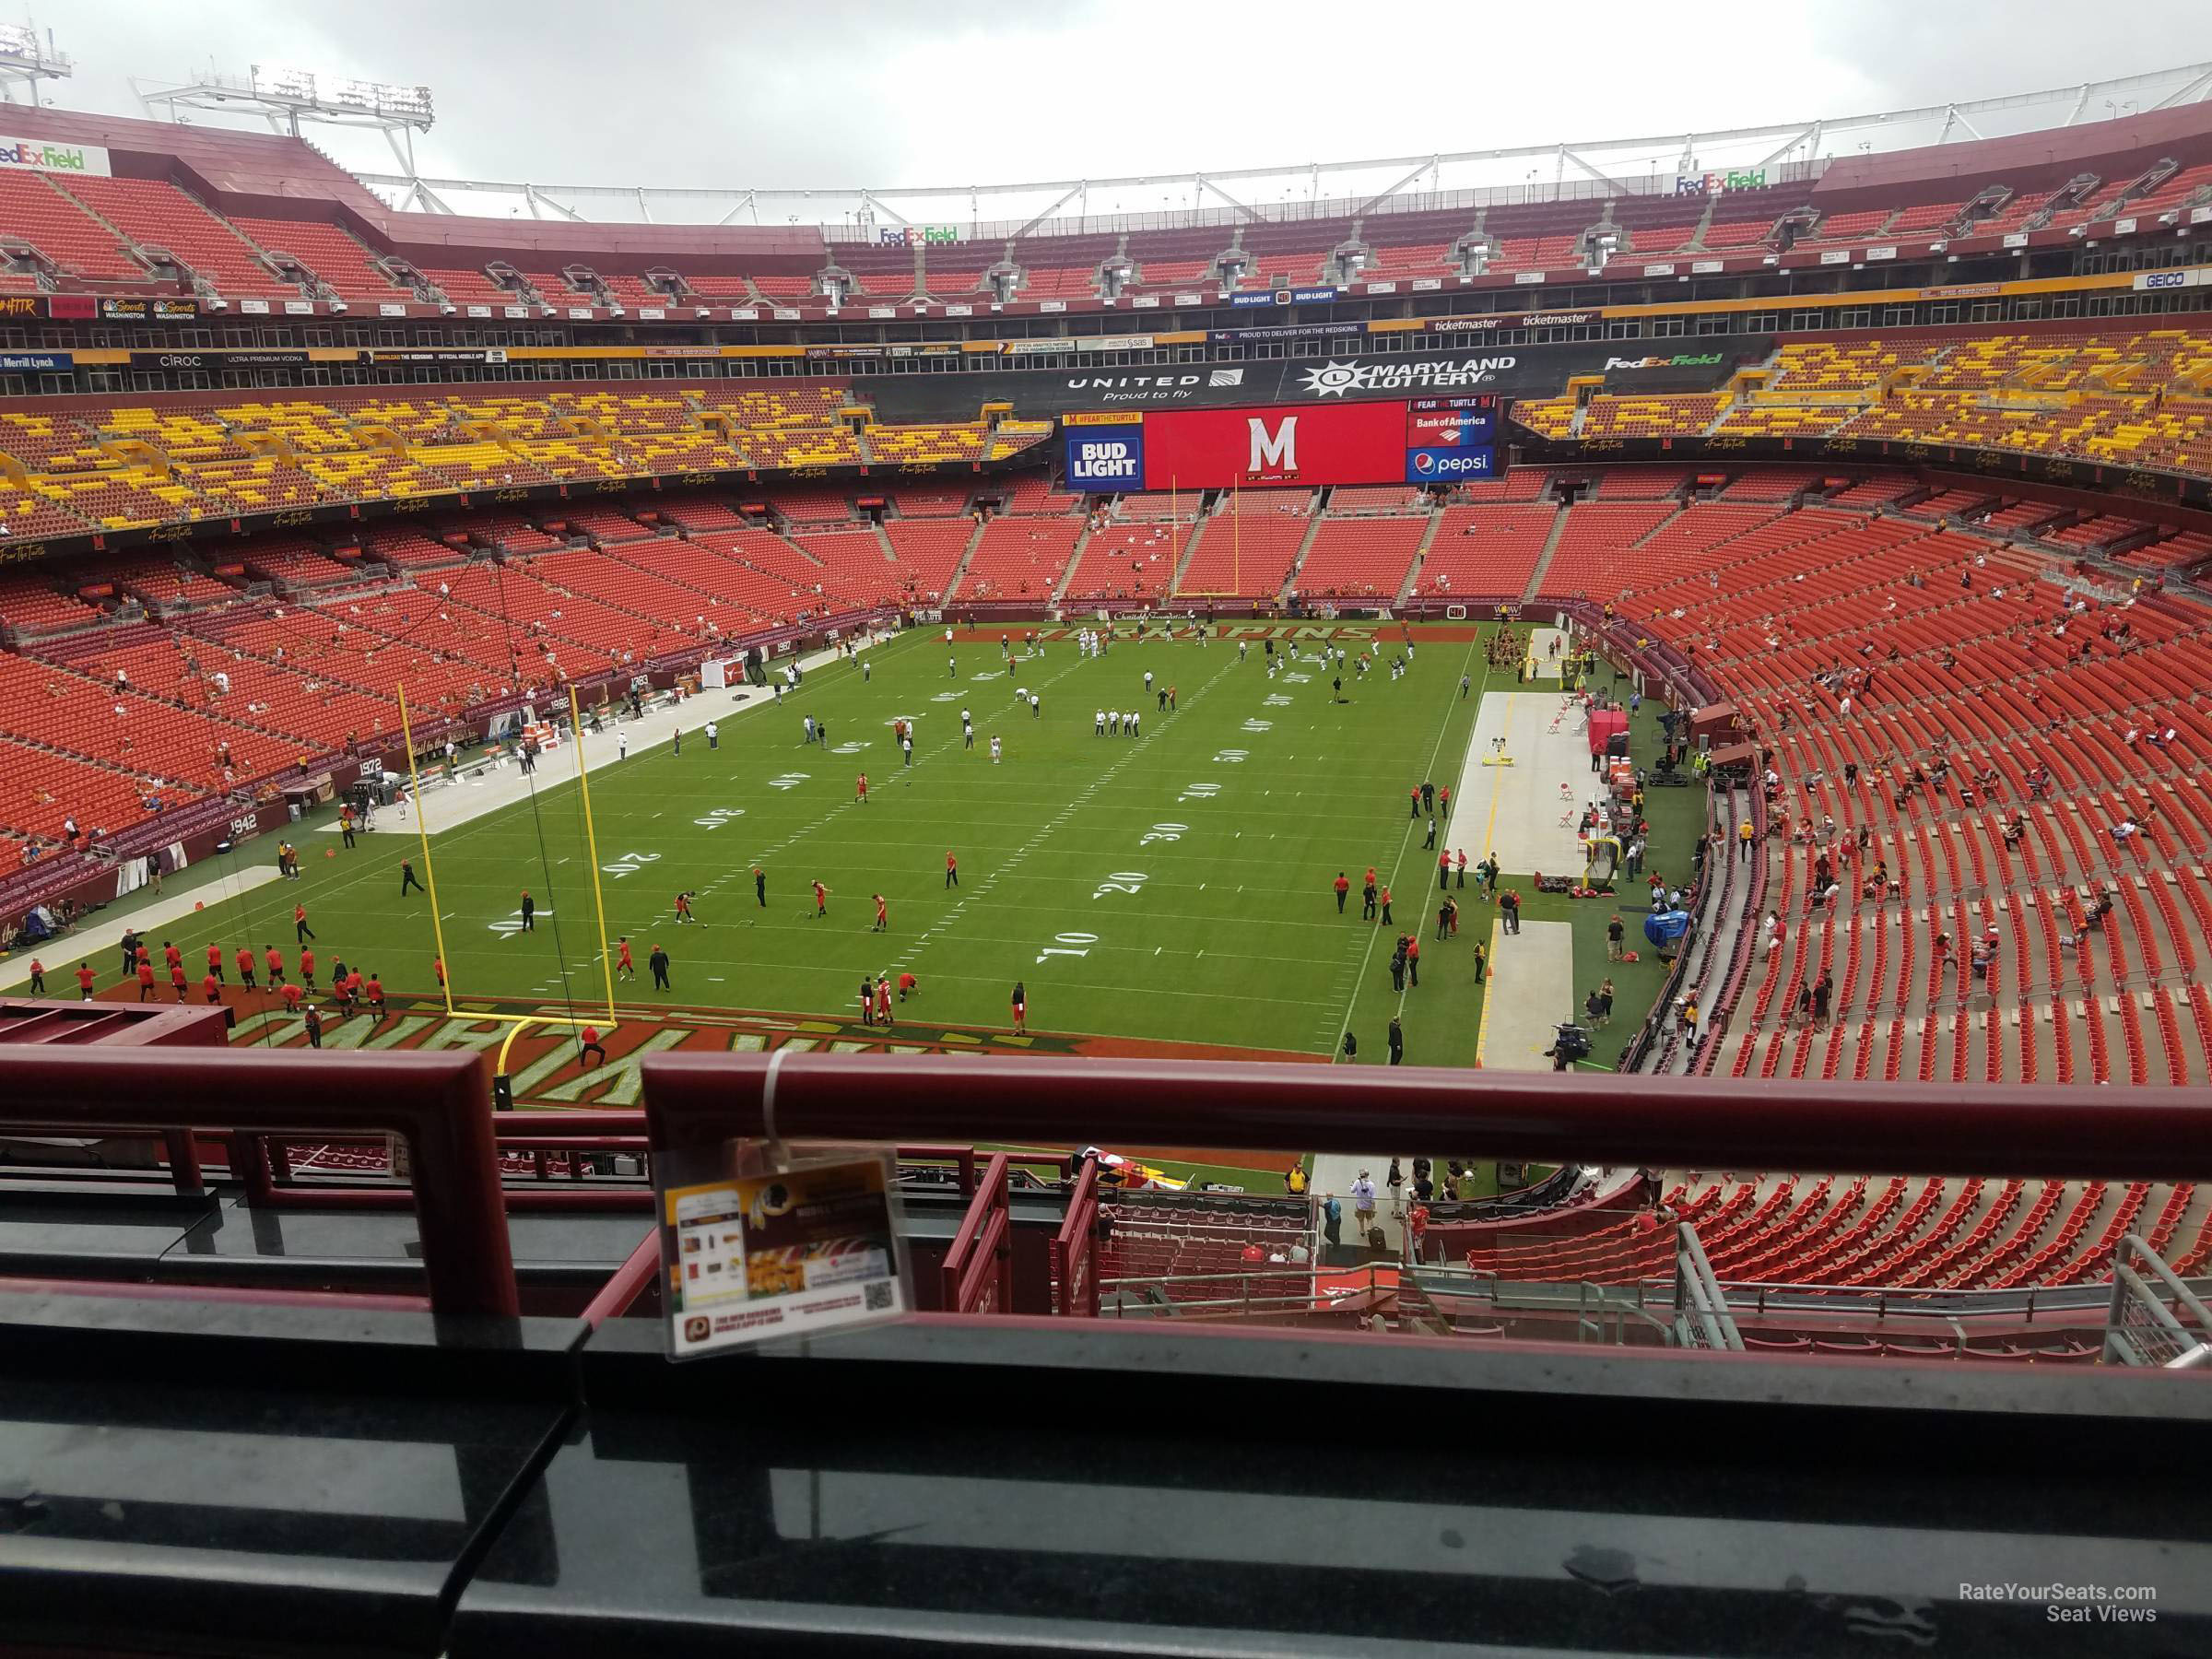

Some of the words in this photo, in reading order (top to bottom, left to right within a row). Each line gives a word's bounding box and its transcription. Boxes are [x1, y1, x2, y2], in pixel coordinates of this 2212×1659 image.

[0, 143, 85, 170] edExField
[1676, 169, 1766, 192] FedExField
[880, 227, 958, 243] FedExField
[2147, 272, 2183, 288] GEICO
[1277, 293, 1288, 301] 40
[117, 300, 147, 312] Sports
[167, 300, 195, 313] Sports
[1435, 320, 1498, 331] ticketmaster
[1523, 313, 1587, 325] ticketmaster
[4, 357, 30, 366] Merrill
[32, 357, 53, 368] Lynch
[1371, 357, 1516, 376] MARYLAND
[1605, 353, 1724, 371] FedExField
[1068, 376, 1200, 388] UNITED
[1367, 371, 1487, 388] LOTTERY
[1103, 390, 1148, 401] Proud
[1152, 390, 1169, 399] to
[1171, 389, 1193, 399] fly
[1079, 414, 1136, 423] #FEARTHETURTLE
[1417, 418, 1438, 428] Bank
[1440, 418, 1449, 426] of
[1449, 417, 1486, 427] America
[1082, 442, 1127, 460] BUD
[1246, 416, 1299, 472] M
[1074, 459, 1136, 477] LIGHT
[1438, 454, 1487, 474] pepsi
[1038, 627, 1382, 642] TERRAPINS
[550, 697, 570, 710] 1982
[359, 758, 382, 776] 1972
[1182, 783, 1222, 799] 40
[230, 813, 257, 835] 1942
[693, 808, 746, 826] 30
[1143, 822, 1190, 841] 30
[601, 853, 662, 873] 20
[1097, 871, 1149, 894] 20
[1041, 931, 1100, 958] 10
